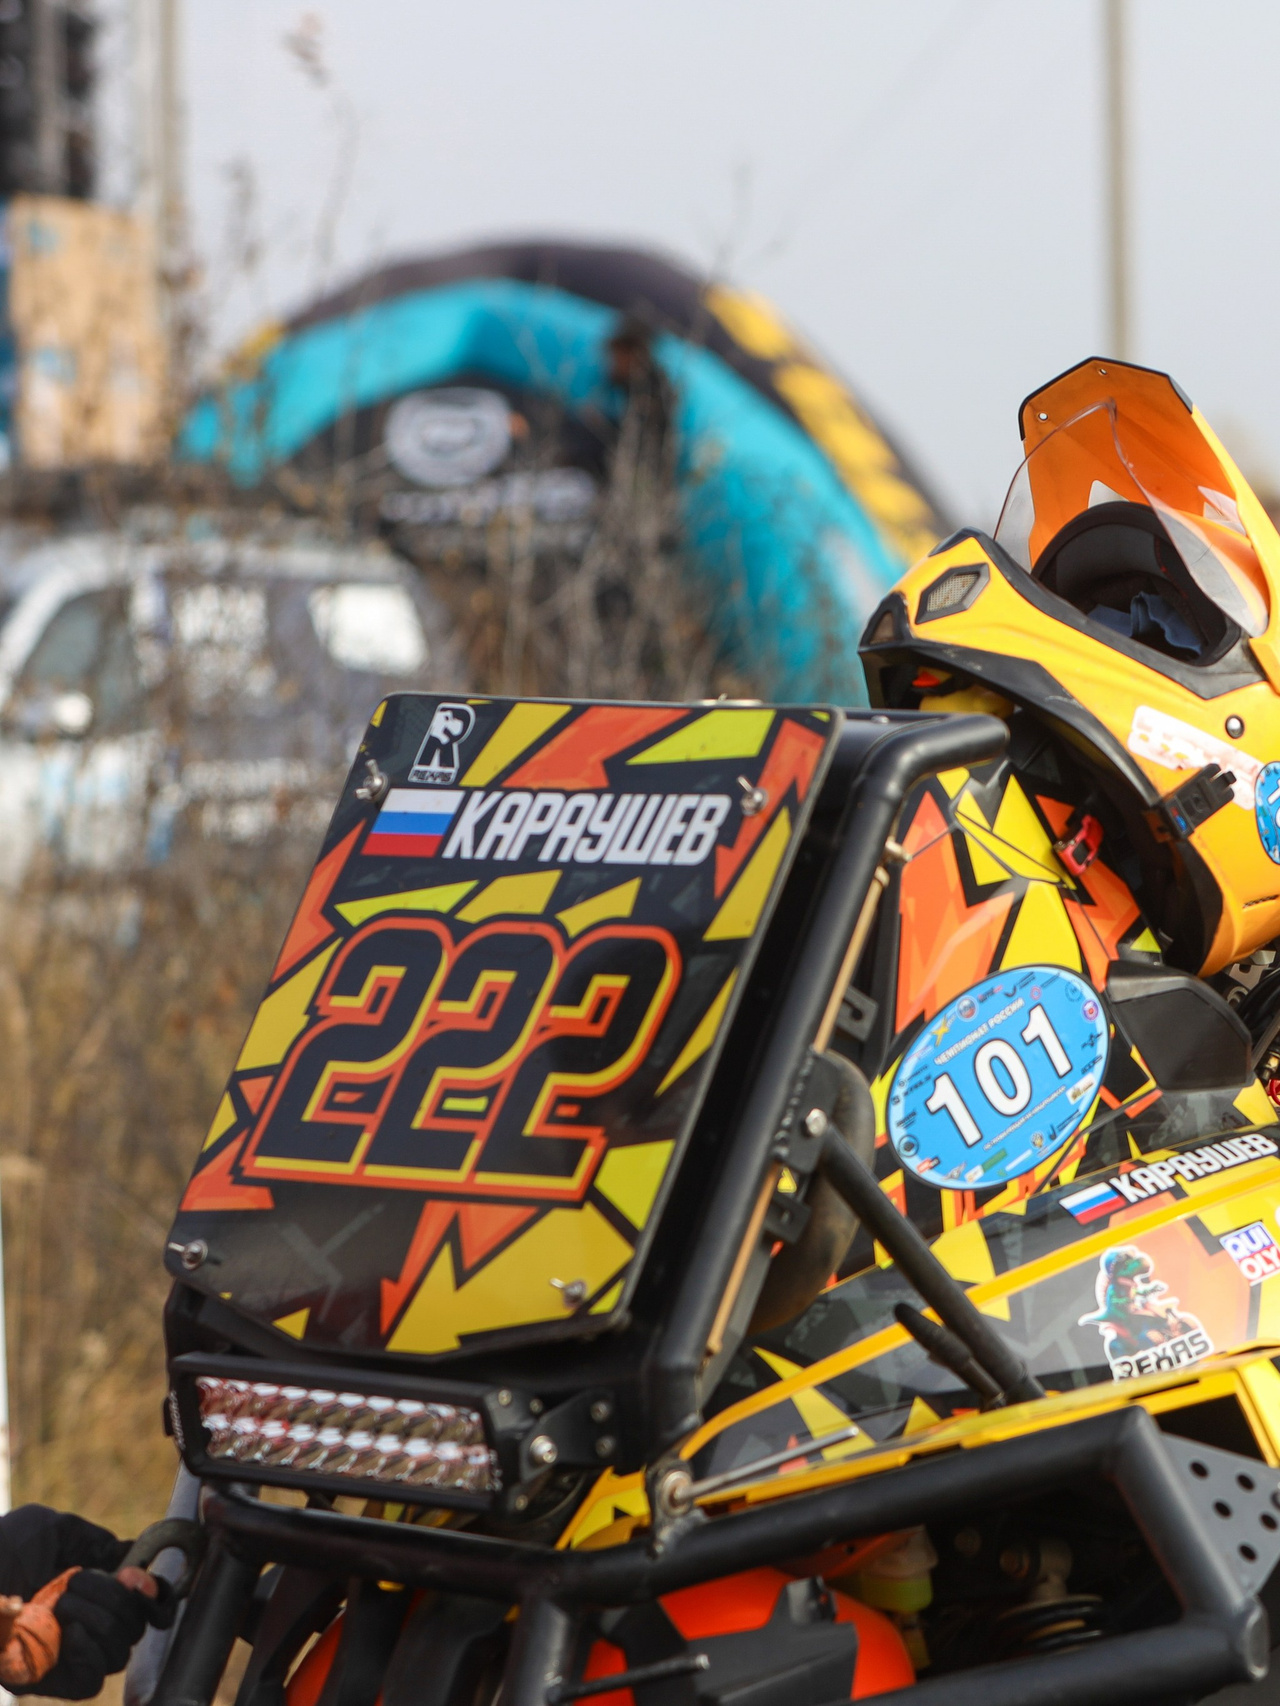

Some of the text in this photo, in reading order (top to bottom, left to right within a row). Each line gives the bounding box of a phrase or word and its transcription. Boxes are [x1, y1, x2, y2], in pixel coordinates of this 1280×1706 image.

[442, 790, 732, 866] КАРАУШЕВ
[239, 917, 682, 1200] 222
[925, 1003, 1073, 1148] 101
[1110, 1133, 1278, 1203] КАРАУШЕВ
